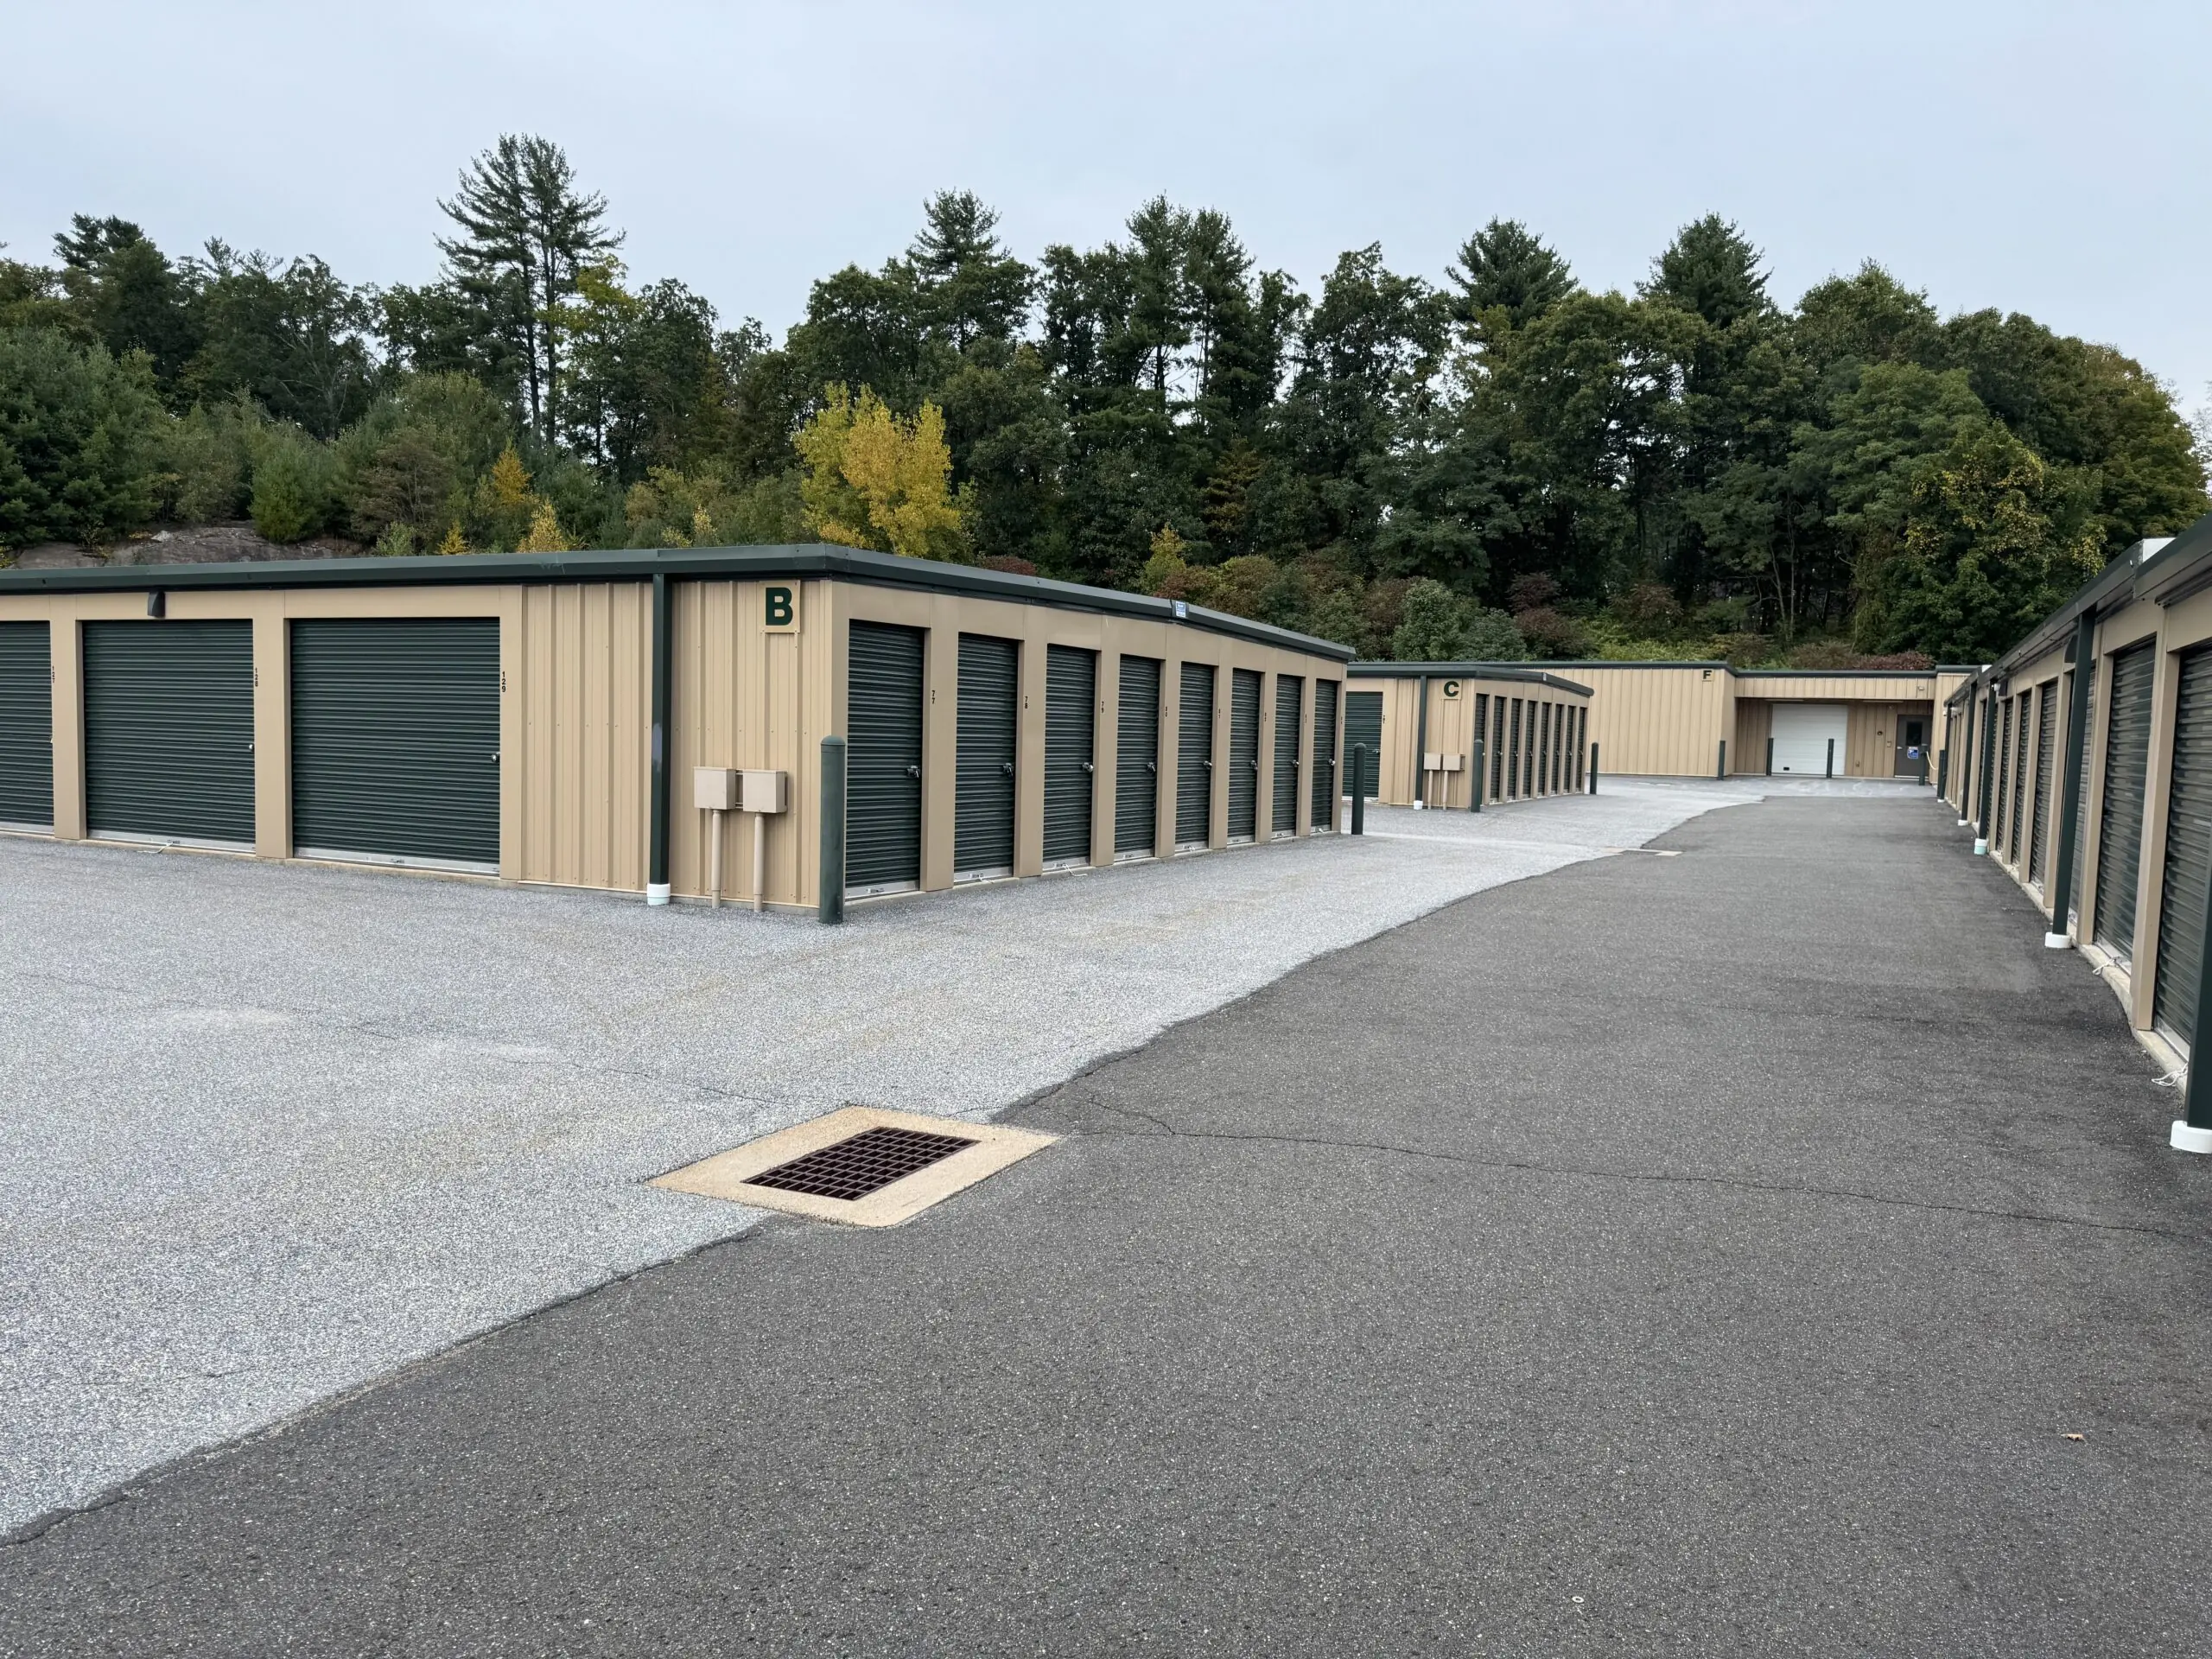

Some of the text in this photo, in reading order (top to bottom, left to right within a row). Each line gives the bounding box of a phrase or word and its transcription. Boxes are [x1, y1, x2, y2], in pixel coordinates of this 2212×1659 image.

[765, 587, 793, 626] B
[1702, 670, 1713, 680] F
[1443, 680, 1459, 697] C
[931, 690, 936, 704] 77
[1024, 696, 1028, 709] 78
